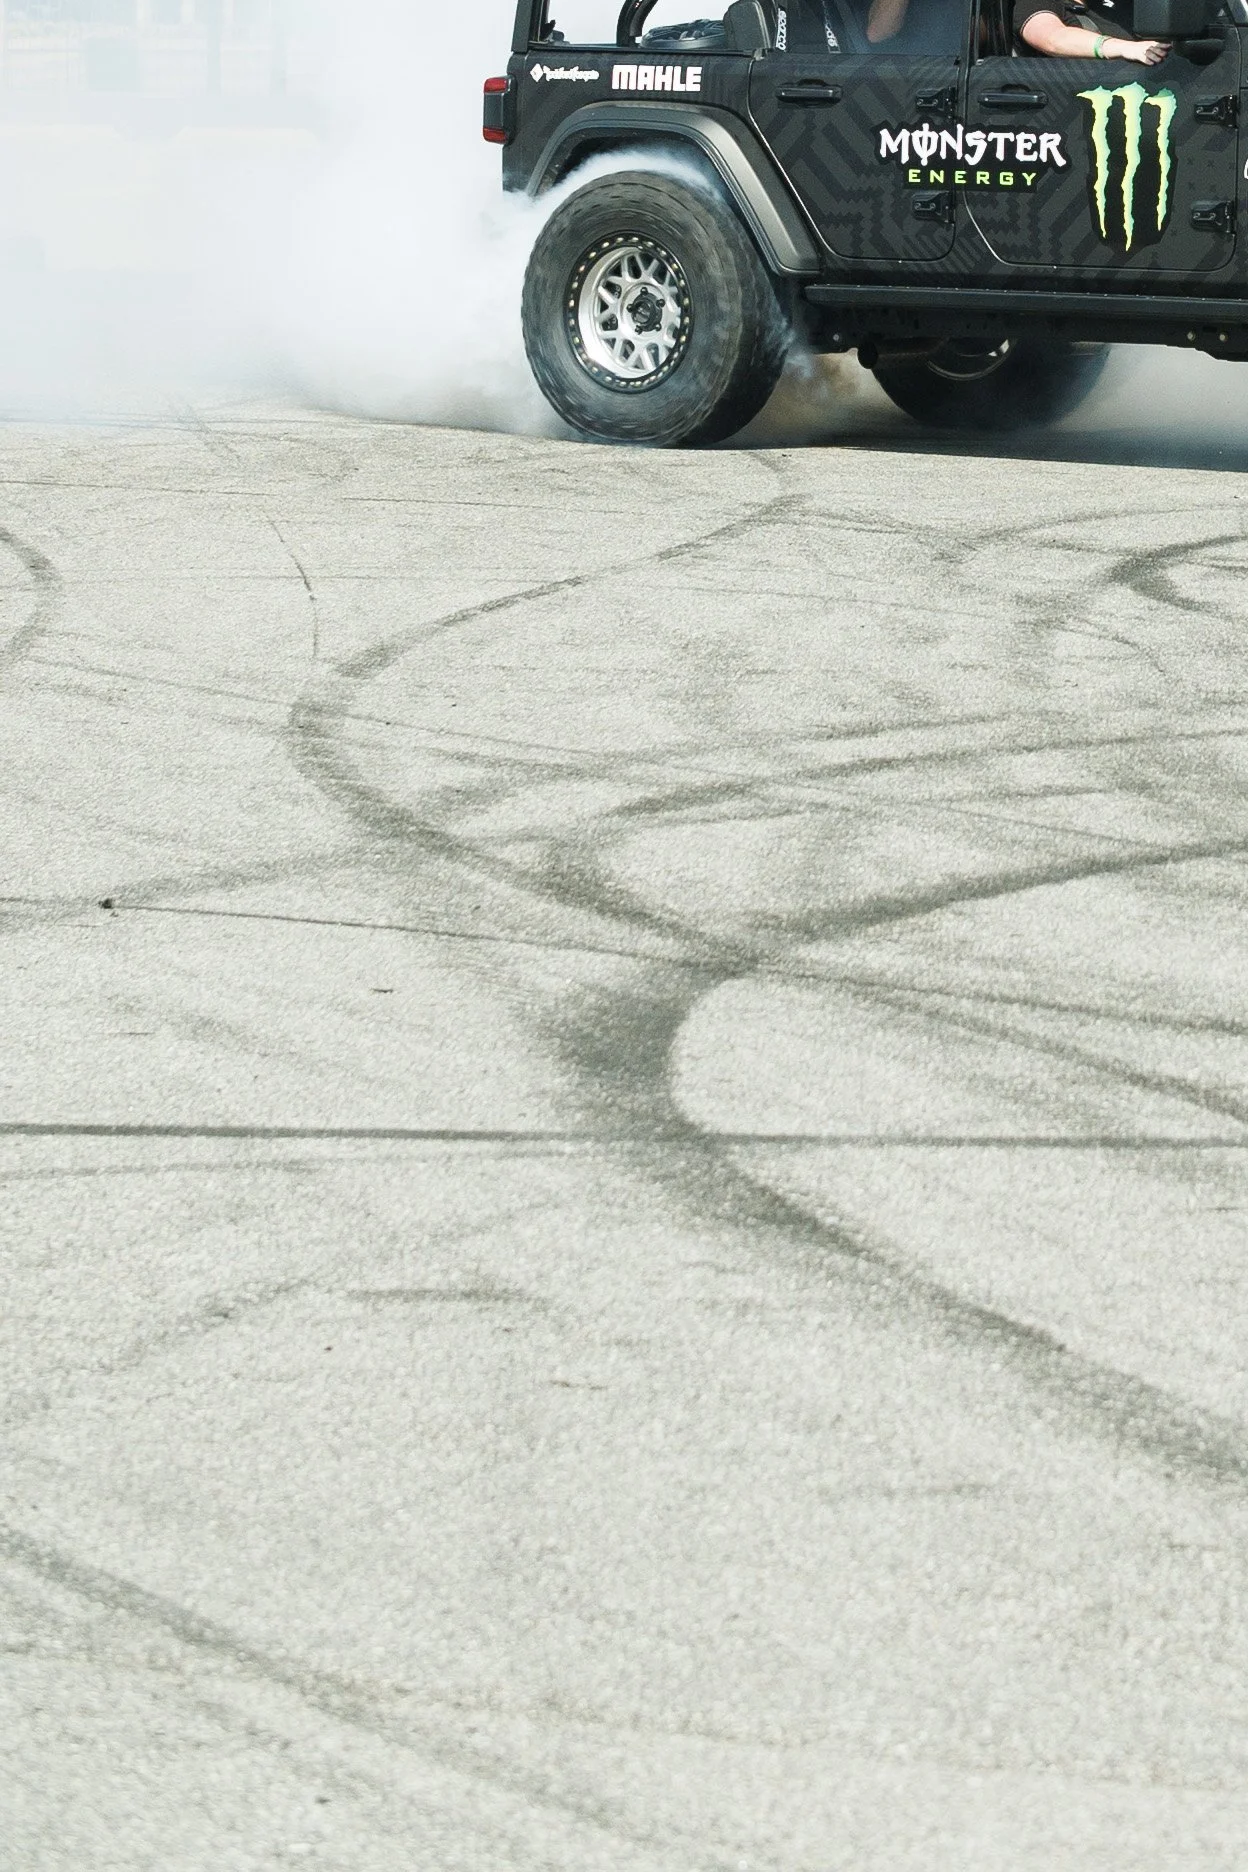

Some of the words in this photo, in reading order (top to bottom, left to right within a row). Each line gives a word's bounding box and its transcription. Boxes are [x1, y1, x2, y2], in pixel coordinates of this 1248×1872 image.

[611, 64, 703, 92] MAHLE
[879, 122, 1067, 167] MONSTER
[908, 168, 1037, 186] ENERGY
